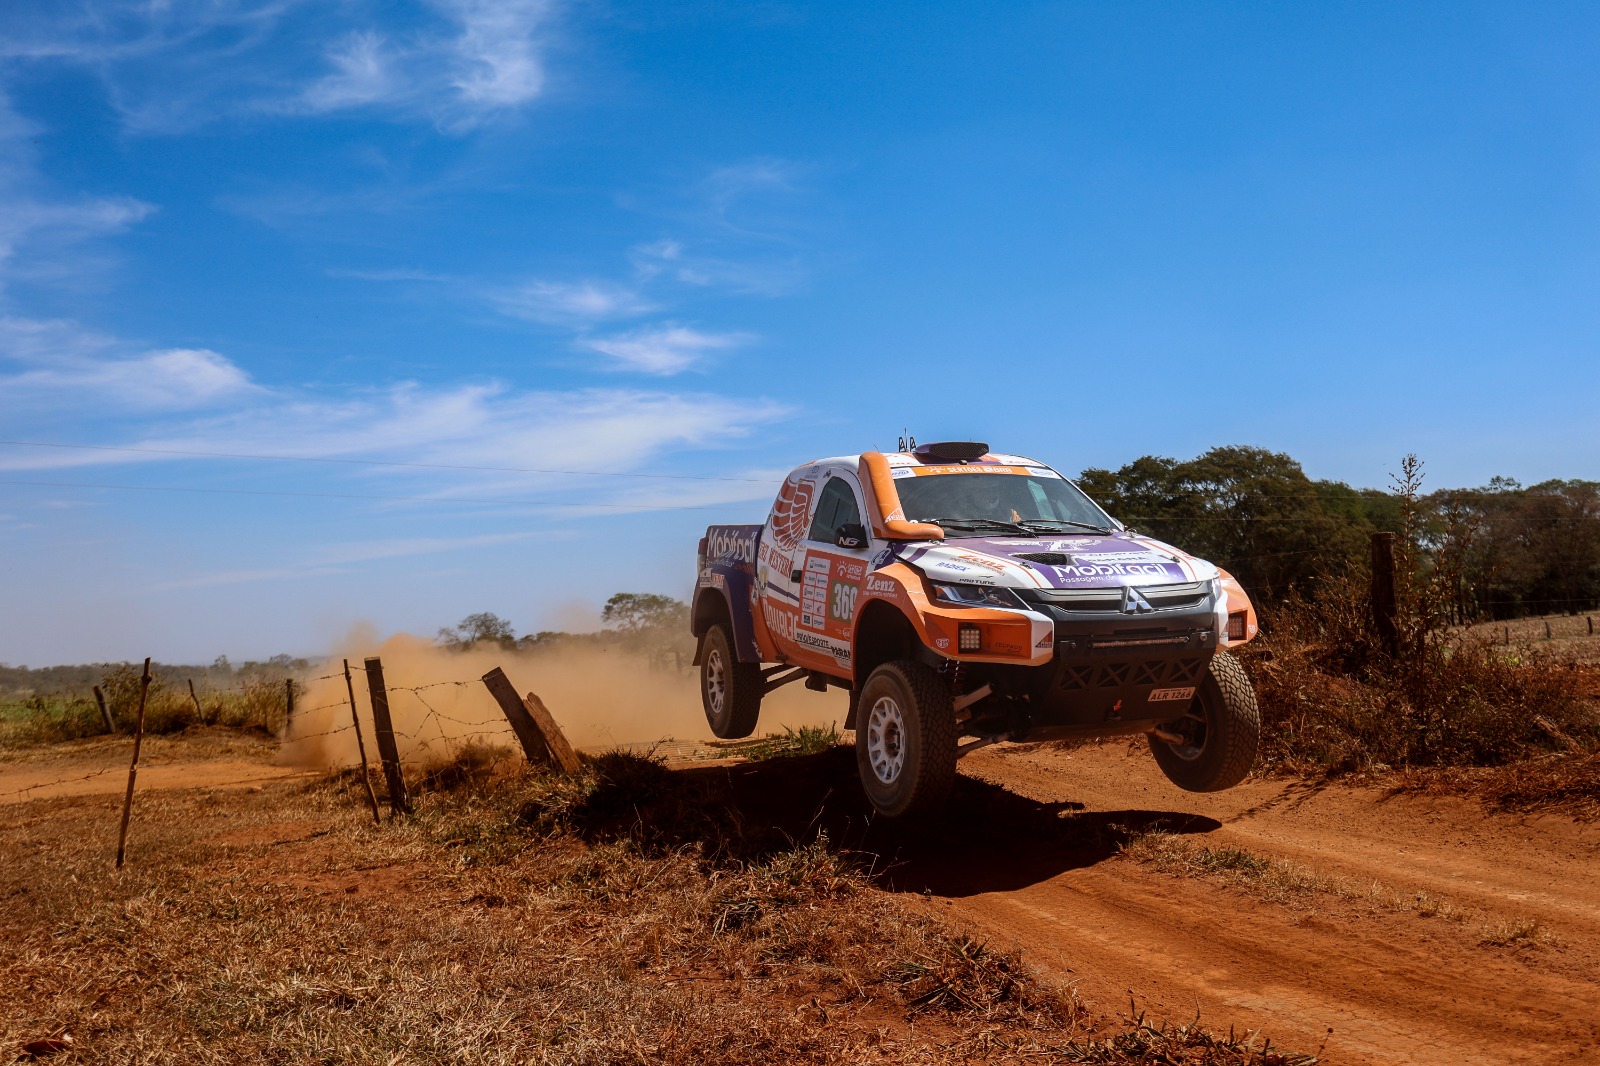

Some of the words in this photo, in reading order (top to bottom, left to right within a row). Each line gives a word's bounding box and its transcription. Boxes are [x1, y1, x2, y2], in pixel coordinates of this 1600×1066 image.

[838, 536, 860, 546] NG
[867, 575, 895, 592] Zenz
[1060, 575, 1104, 585] Passagem
[1150, 692, 1169, 701] ALR
[1171, 690, 1192, 699] 1266
